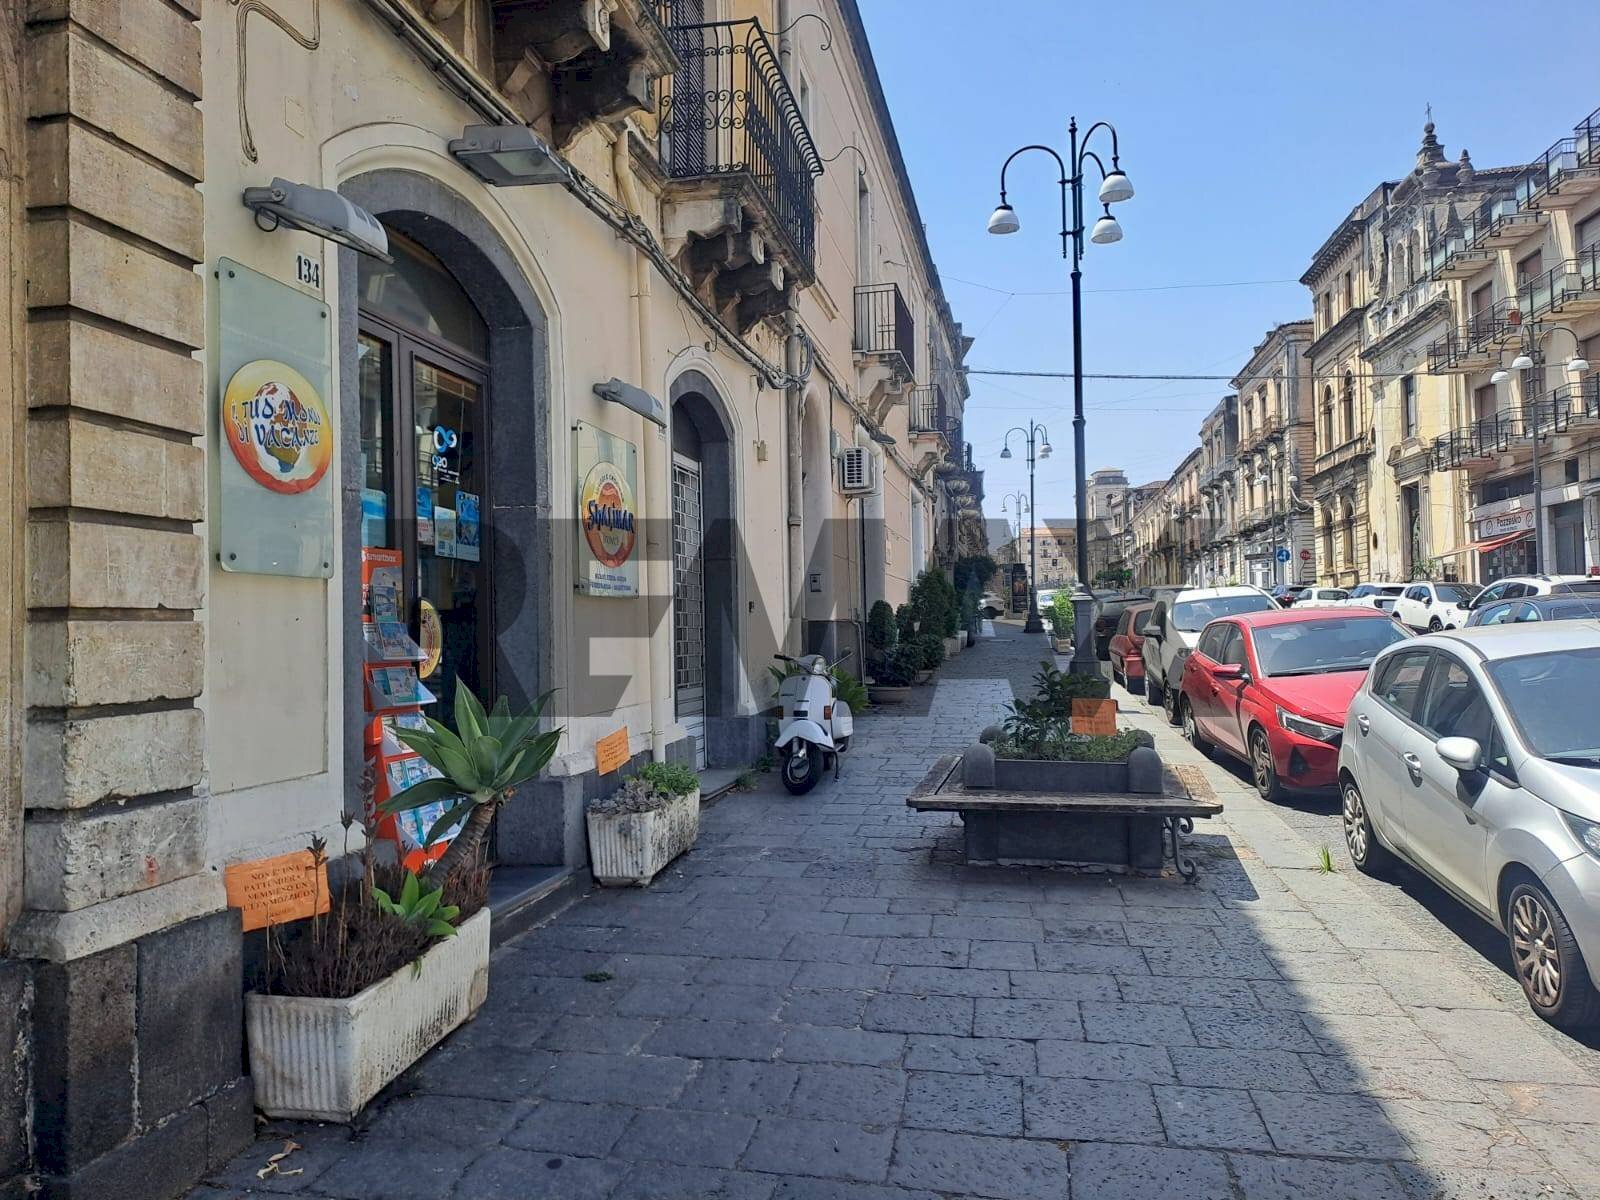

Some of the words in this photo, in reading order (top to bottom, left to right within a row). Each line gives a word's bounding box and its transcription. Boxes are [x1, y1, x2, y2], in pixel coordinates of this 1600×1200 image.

[296, 255, 320, 288] 134
[242, 397, 275, 420] TUO
[254, 424, 319, 448] VACANZE
